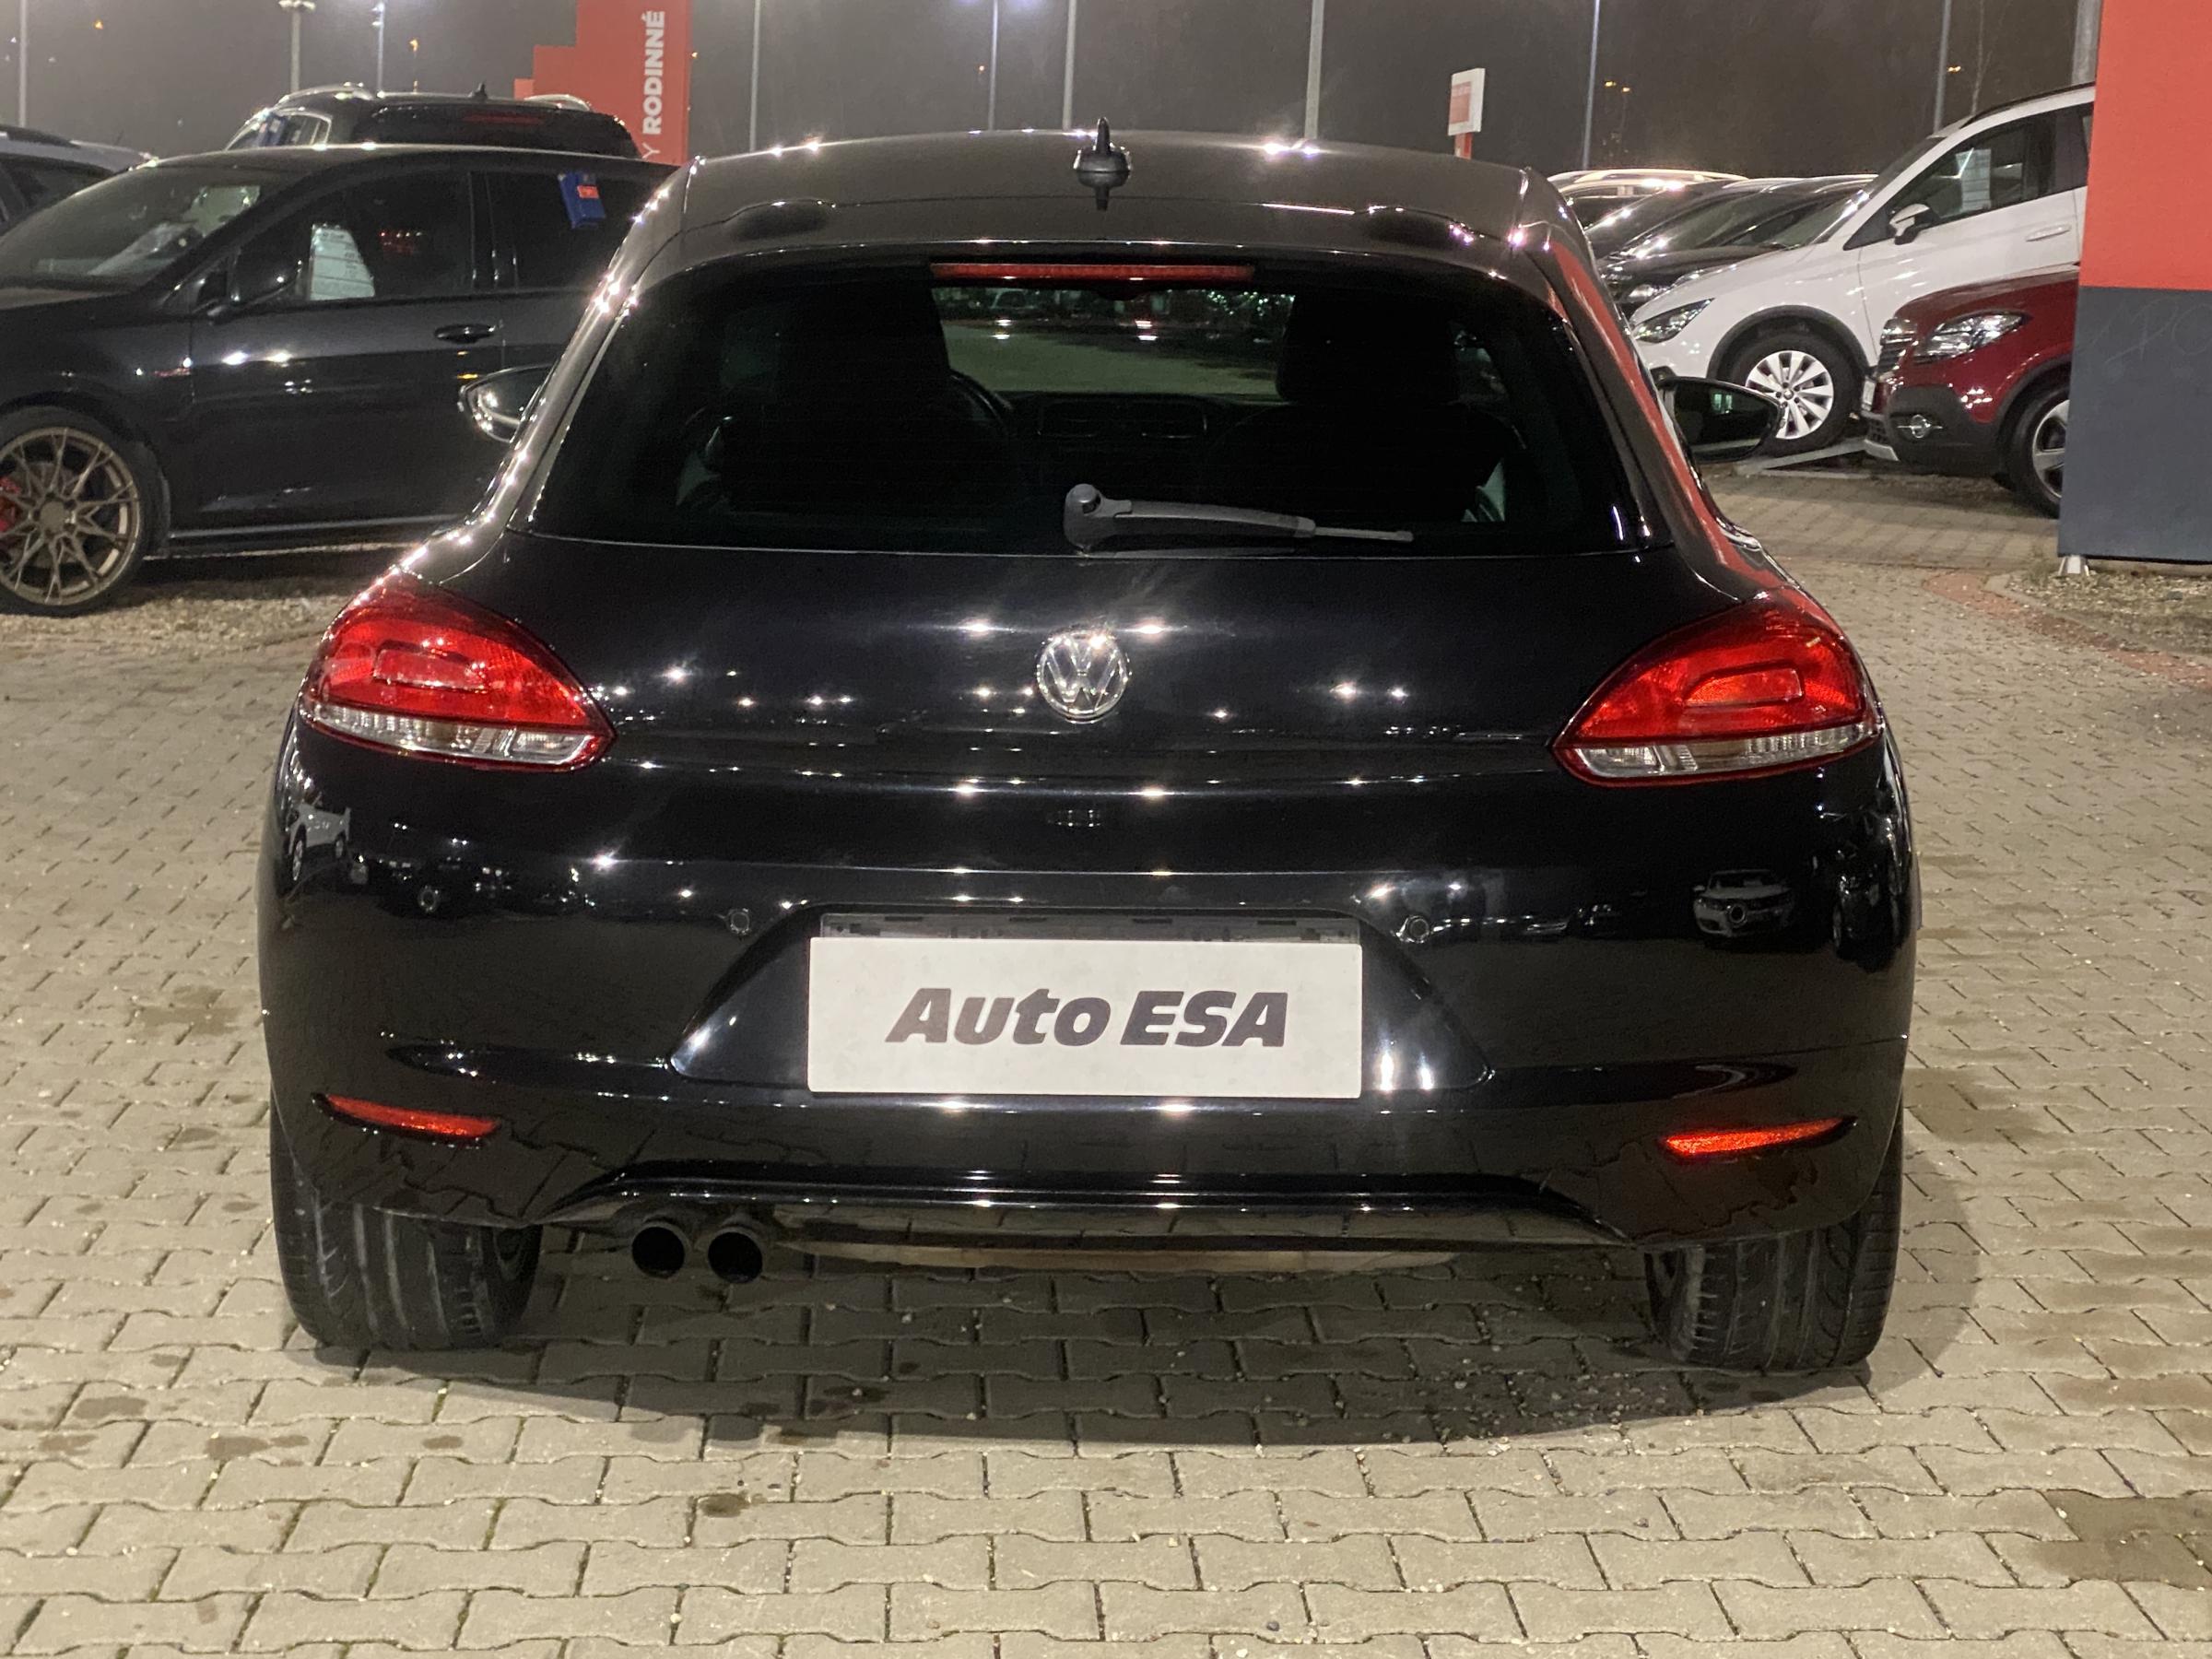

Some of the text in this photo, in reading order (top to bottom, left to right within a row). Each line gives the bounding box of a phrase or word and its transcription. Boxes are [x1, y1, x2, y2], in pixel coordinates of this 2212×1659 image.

[641, 10, 665, 135] RODINNÉ
[1039, 632, 1129, 716] VW
[885, 988, 1288, 1047] Auto ESA
